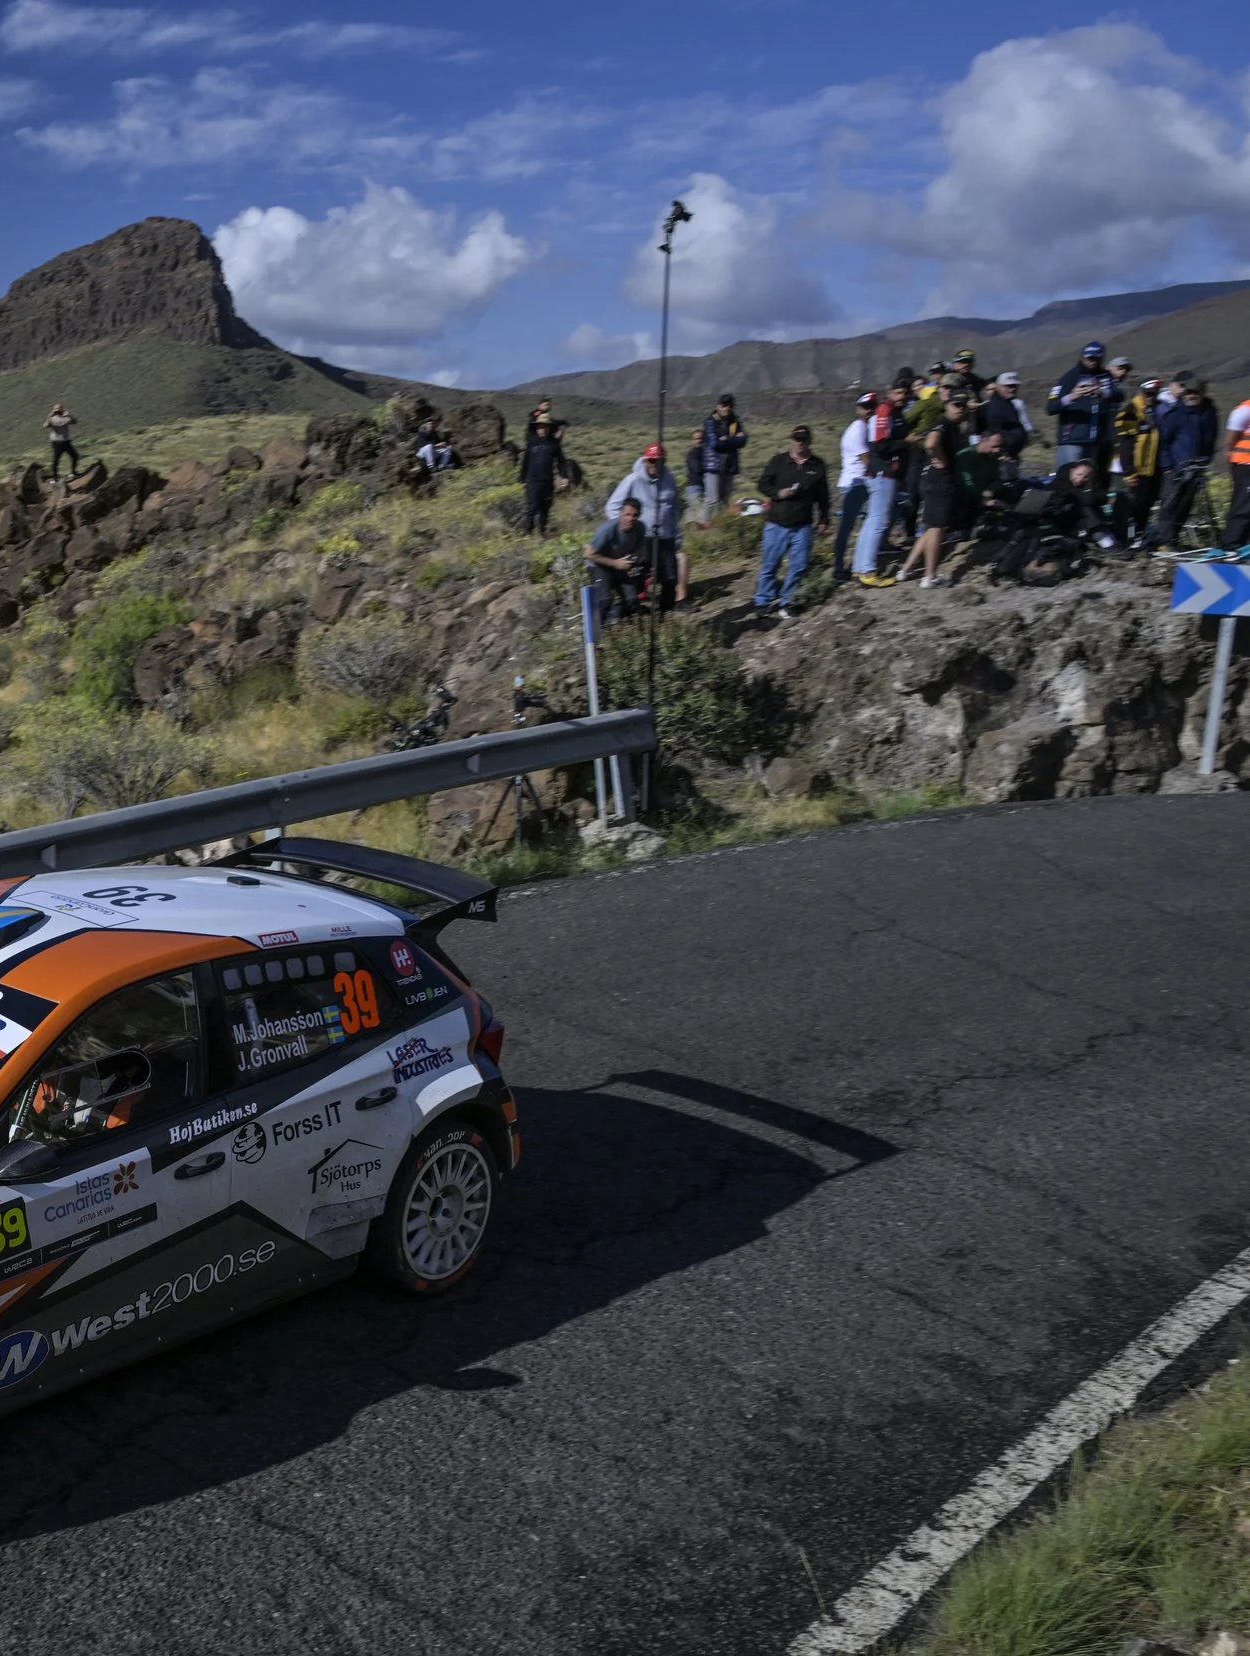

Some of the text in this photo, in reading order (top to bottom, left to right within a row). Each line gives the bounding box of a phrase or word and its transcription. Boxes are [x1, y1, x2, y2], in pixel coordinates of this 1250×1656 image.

[82, 885, 177, 907] 39
[469, 901, 485, 913] MS
[262, 932, 297, 946] MOTUL
[334, 968, 381, 1034] 39
[272, 1101, 342, 1146] Forss IT
[75, 1172, 110, 1196] Islas
[320, 1157, 382, 1186] Sjötorps
[340, 1179, 362, 1192] Hus
[44, 1187, 112, 1222] Canarias
[51, 1240, 277, 1356] West2000.se
